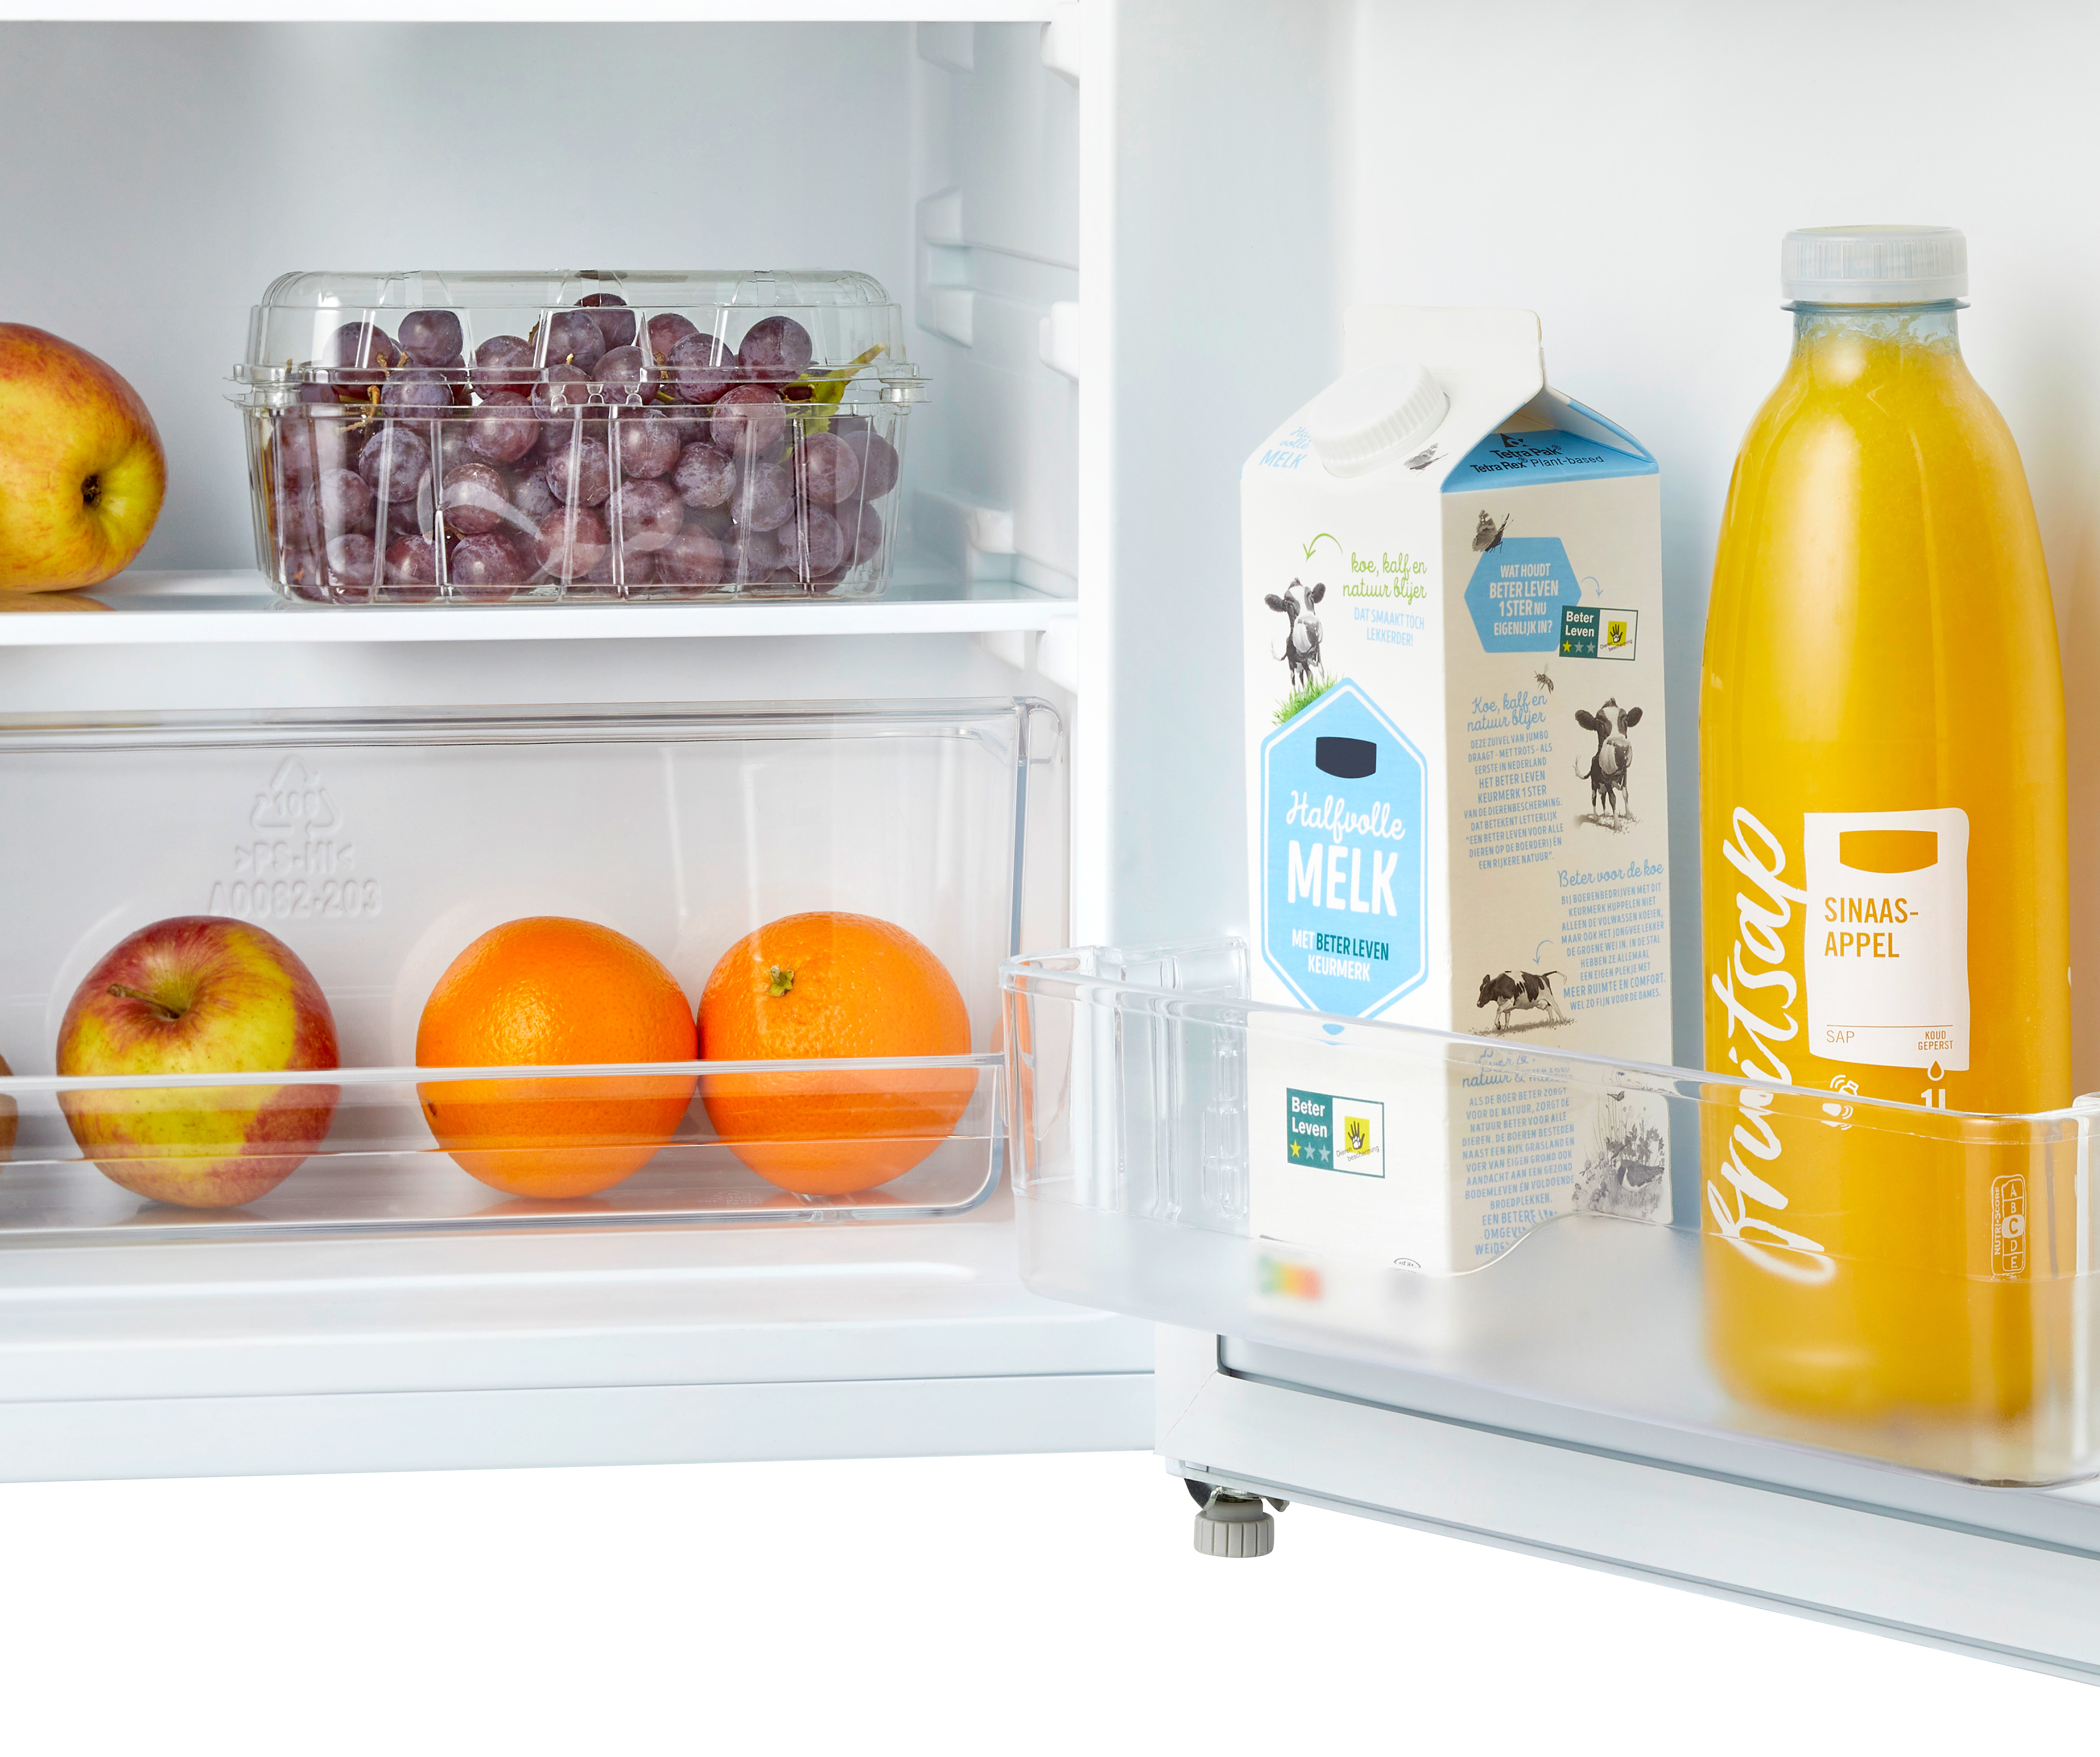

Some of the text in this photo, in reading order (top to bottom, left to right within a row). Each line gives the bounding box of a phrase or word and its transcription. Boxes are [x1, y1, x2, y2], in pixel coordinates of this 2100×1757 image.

[1259, 449, 1308, 469] MELK
[1489, 449, 1531, 459] Tetra
[1530, 456, 1604, 467] Plant-based
[1352, 552, 1426, 581] koe, kalf en
[1500, 563, 1551, 578] WAT HOUDT
[1343, 577, 1426, 605] natuur blijer
[1490, 580, 1558, 599] BETER LEVEN
[1354, 607, 1369, 621] DAT
[1372, 609, 1404, 626] SMAAKT
[1499, 600, 1546, 616] 1 STER NU
[1566, 611, 1594, 623] Beter
[1367, 627, 1413, 647] LEKKERDER!
[1494, 620, 1552, 636] EIGENLIJK IN?
[1565, 625, 1594, 637] Leven
[1473, 691, 1547, 714] Koe, kalf en
[1467, 708, 1546, 732] natuur blijer
[1471, 731, 1548, 749] DEZE ZUIVEL VAN JUMBO
[1468, 743, 1552, 762] DRAAGT MET TROTS ALS
[1475, 757, 1546, 774] EERSTE IN NEDERLAND
[1479, 770, 1545, 788] HET BETER LEVEN
[1478, 788, 1520, 803] KEURMERK
[1528, 785, 1546, 797] STER
[1286, 790, 1405, 844] Halfvolle
[1464, 797, 1562, 819] VAN DE DIERENBESCHERMING.
[1471, 811, 1557, 831] DAT BETEKENT LETTERLIJK
[1484, 832, 1504, 842] BETER
[1506, 828, 1526, 839] LEVEN
[1528, 826, 1546, 836] VOOR
[1548, 823, 1563, 833] ALLE
[1469, 846, 1493, 858] DIEREN
[1495, 845, 1504, 854] OP
[1506, 843, 1514, 852] DE
[1516, 838, 1552, 851] BOERDERIJ
[1479, 859, 1492, 870] EEN
[1493, 856, 1520, 867] RIJKERE
[1288, 840, 1398, 916] MELK
[1558, 859, 1664, 887] Beter voor de koe
[1562, 883, 1661, 905] BIJ BOERENBEDRIJVEN MET DIT
[1569, 896, 1656, 917] KEURMERK HUPPELEN NIET
[1825, 897, 1919, 923] SINAAS-
[1562, 908, 1663, 931] ALLEEN DE VOLWASSEN KOEIEN,
[1562, 921, 1664, 944] MAAR OOK HET JONGVEE LEKKER
[1292, 929, 1389, 961] MET BETER LEVEN
[1567, 935, 1660, 957] DE GROENE WEI IN. IN DE STAL
[1825, 931, 1900, 958] APPEL
[1308, 955, 1370, 982] KEURMERK
[1581, 950, 1649, 968] HEBBEN ZE ALLEMAAL
[1580, 962, 1651, 981] EEN EIGEN PLEKJE MET
[1564, 972, 1665, 998] MEER RUIMTE EN COMFORT.
[1571, 988, 1661, 1010] WEL ZO FIJN VOOR DE DAMES.
[1827, 1030, 1855, 1043] SAP
[1925, 1031, 1946, 1039] KOUD
[1706, 806, 1836, 1285] fruitsap
[1918, 1040, 1954, 1050] GEPERST
[1292, 1096, 1325, 1116] Beter
[1469, 1087, 1566, 1106] ALS DE BOER BETER ZORGT
[1292, 1116, 1327, 1137] Leven
[1336, 1147, 1353, 1157] Dieren
[1347, 1146, 1380, 1162] bescherming
[1466, 1183, 1517, 1199] BODEMLEVEN
[1532, 1175, 1574, 1189] VOLDOENDE
[2010, 1183, 2017, 1197] A
[1491, 1193, 1552, 1209] BROEDPLEKKEN.
[2011, 1202, 2016, 1213] B
[2009, 1218, 2018, 1234] C
[2011, 1240, 2017, 1252] D
[2011, 1256, 2017, 1268] E
